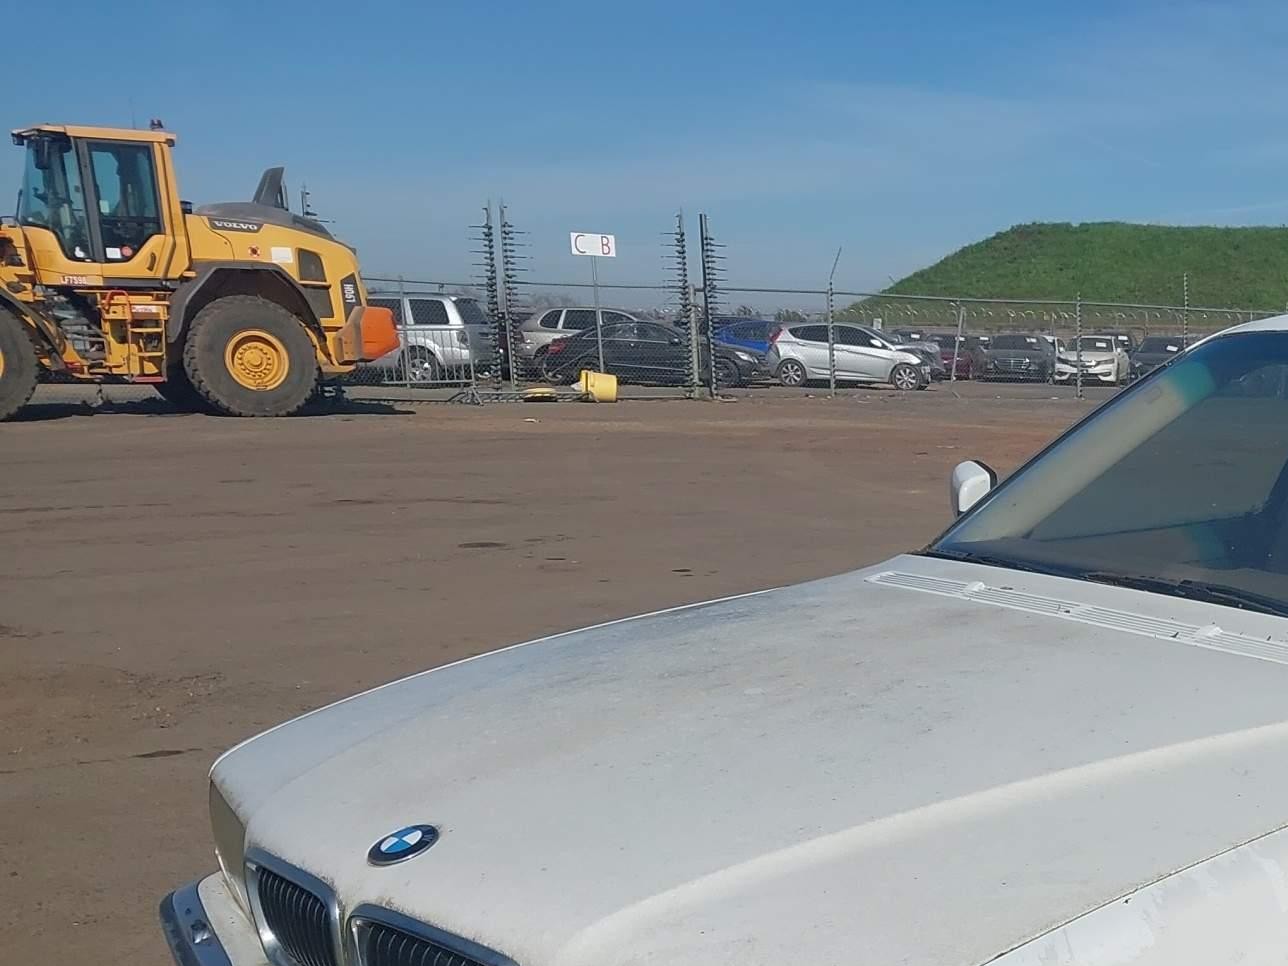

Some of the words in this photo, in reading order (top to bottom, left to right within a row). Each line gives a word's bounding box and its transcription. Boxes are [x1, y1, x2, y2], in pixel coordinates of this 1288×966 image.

[213, 220, 258, 230] VOLVO
[575, 234, 586, 254] C
[601, 235, 610, 255] B
